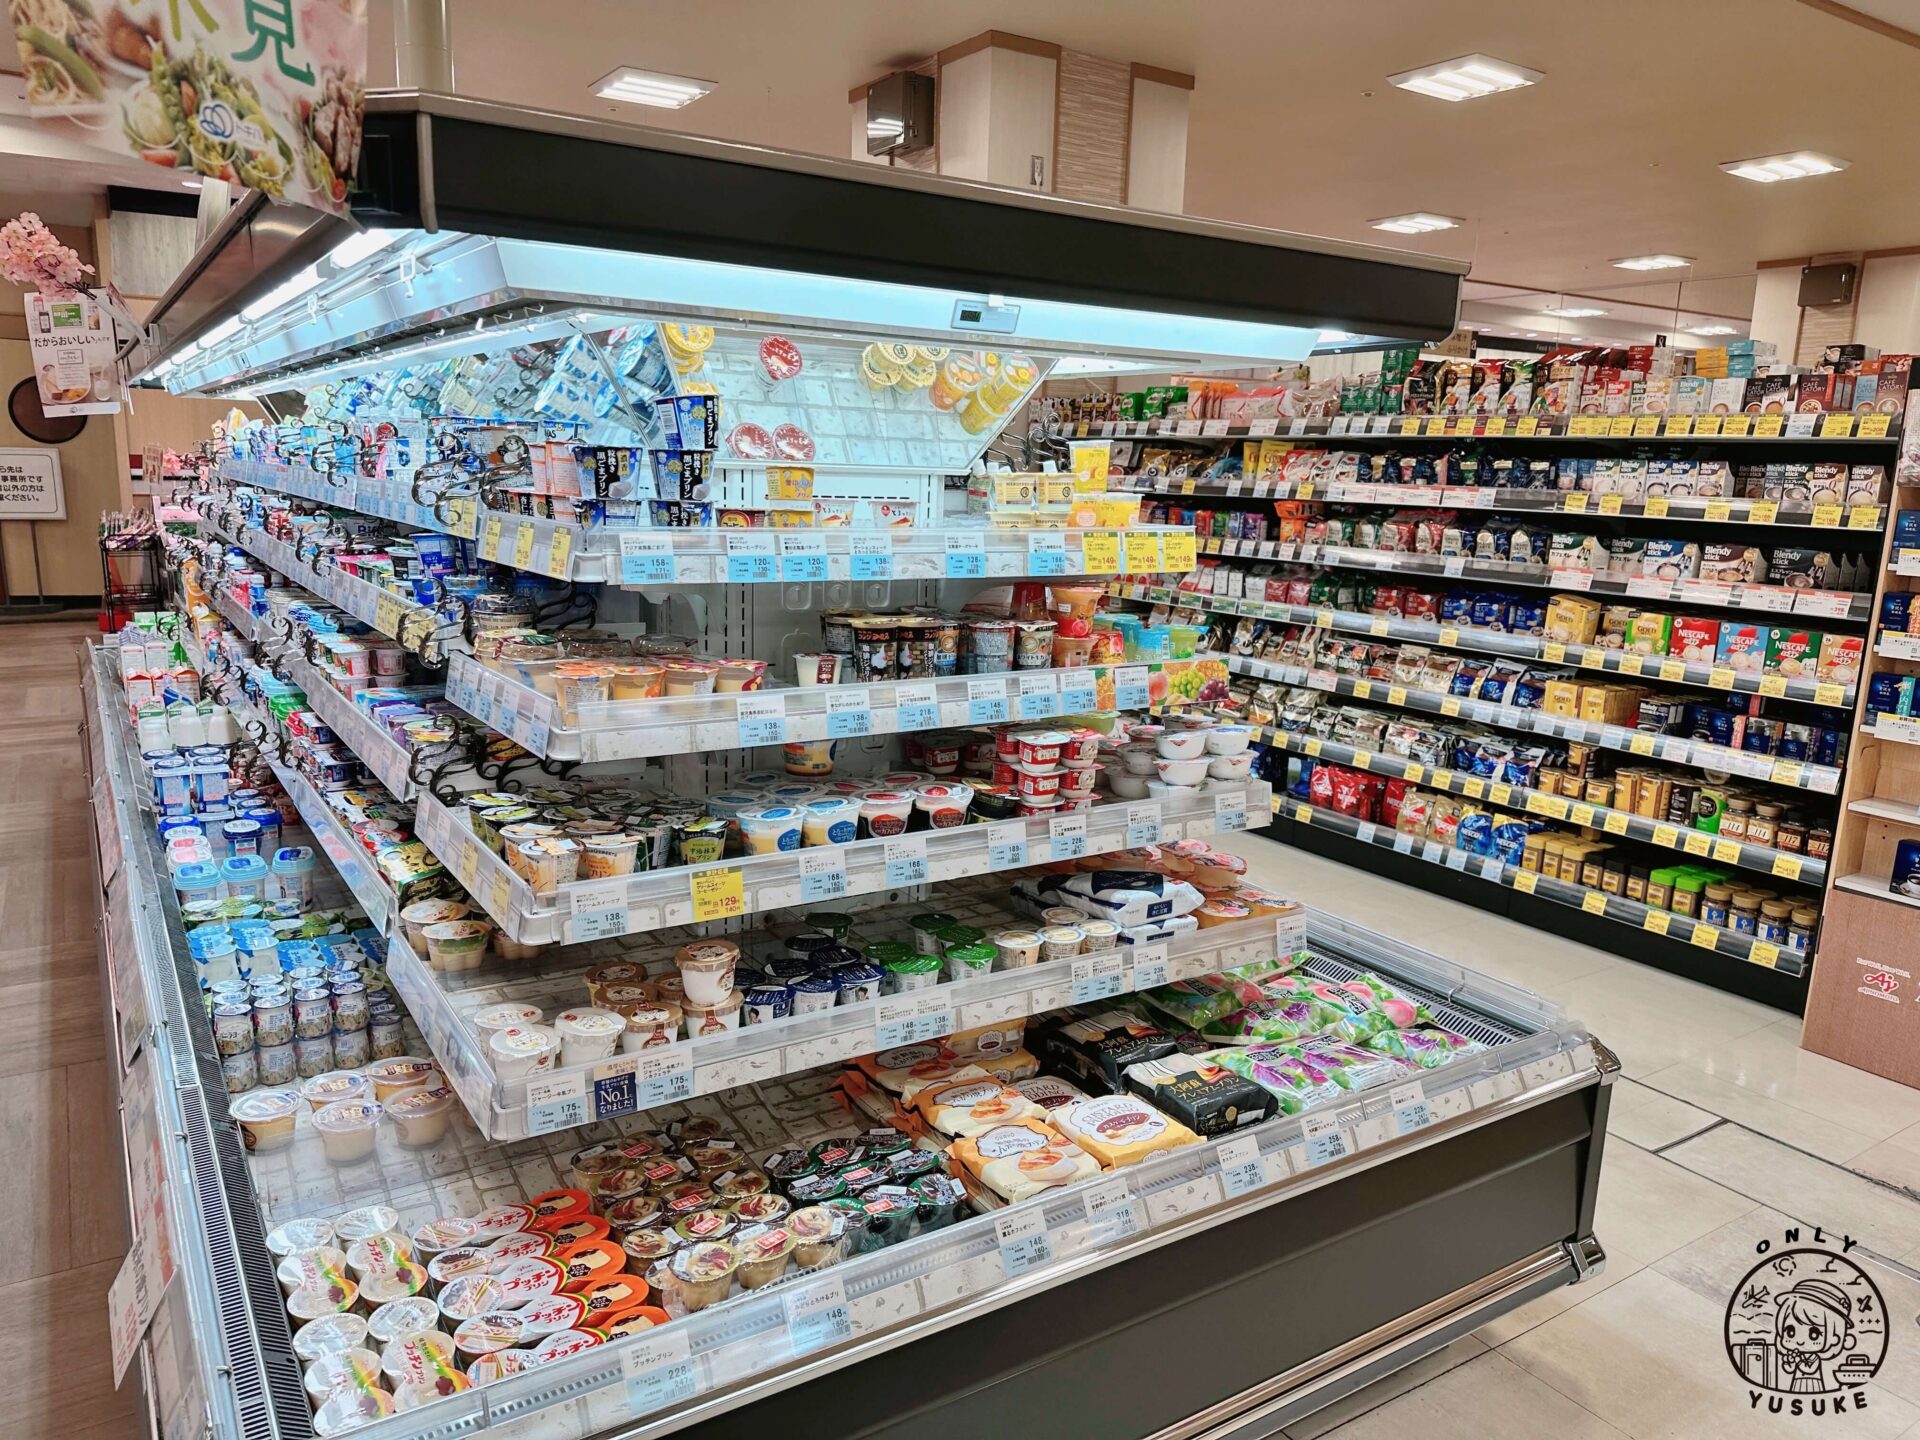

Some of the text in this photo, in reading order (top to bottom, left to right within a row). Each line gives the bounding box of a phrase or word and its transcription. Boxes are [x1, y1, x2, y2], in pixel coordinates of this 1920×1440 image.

[1785, 464, 1808, 473] Blendy
[1814, 466, 1838, 475] Blendy
[1852, 467, 1875, 476] Blendy
[0, 484, 45, 493] 以外の方は
[1552, 535, 1574, 545] Blendy
[1648, 541, 1672, 551] Blendy
[1705, 545, 1732, 557] Blendy
[1704, 553, 1720, 561] stick
[1773, 550, 1801, 561] Blendy
[478, 1211, 528, 1228] プッチン
[494, 1238, 546, 1258] プッチン
[504, 1268, 560, 1290] プッチン
[524, 1302, 581, 1323] プッチン
